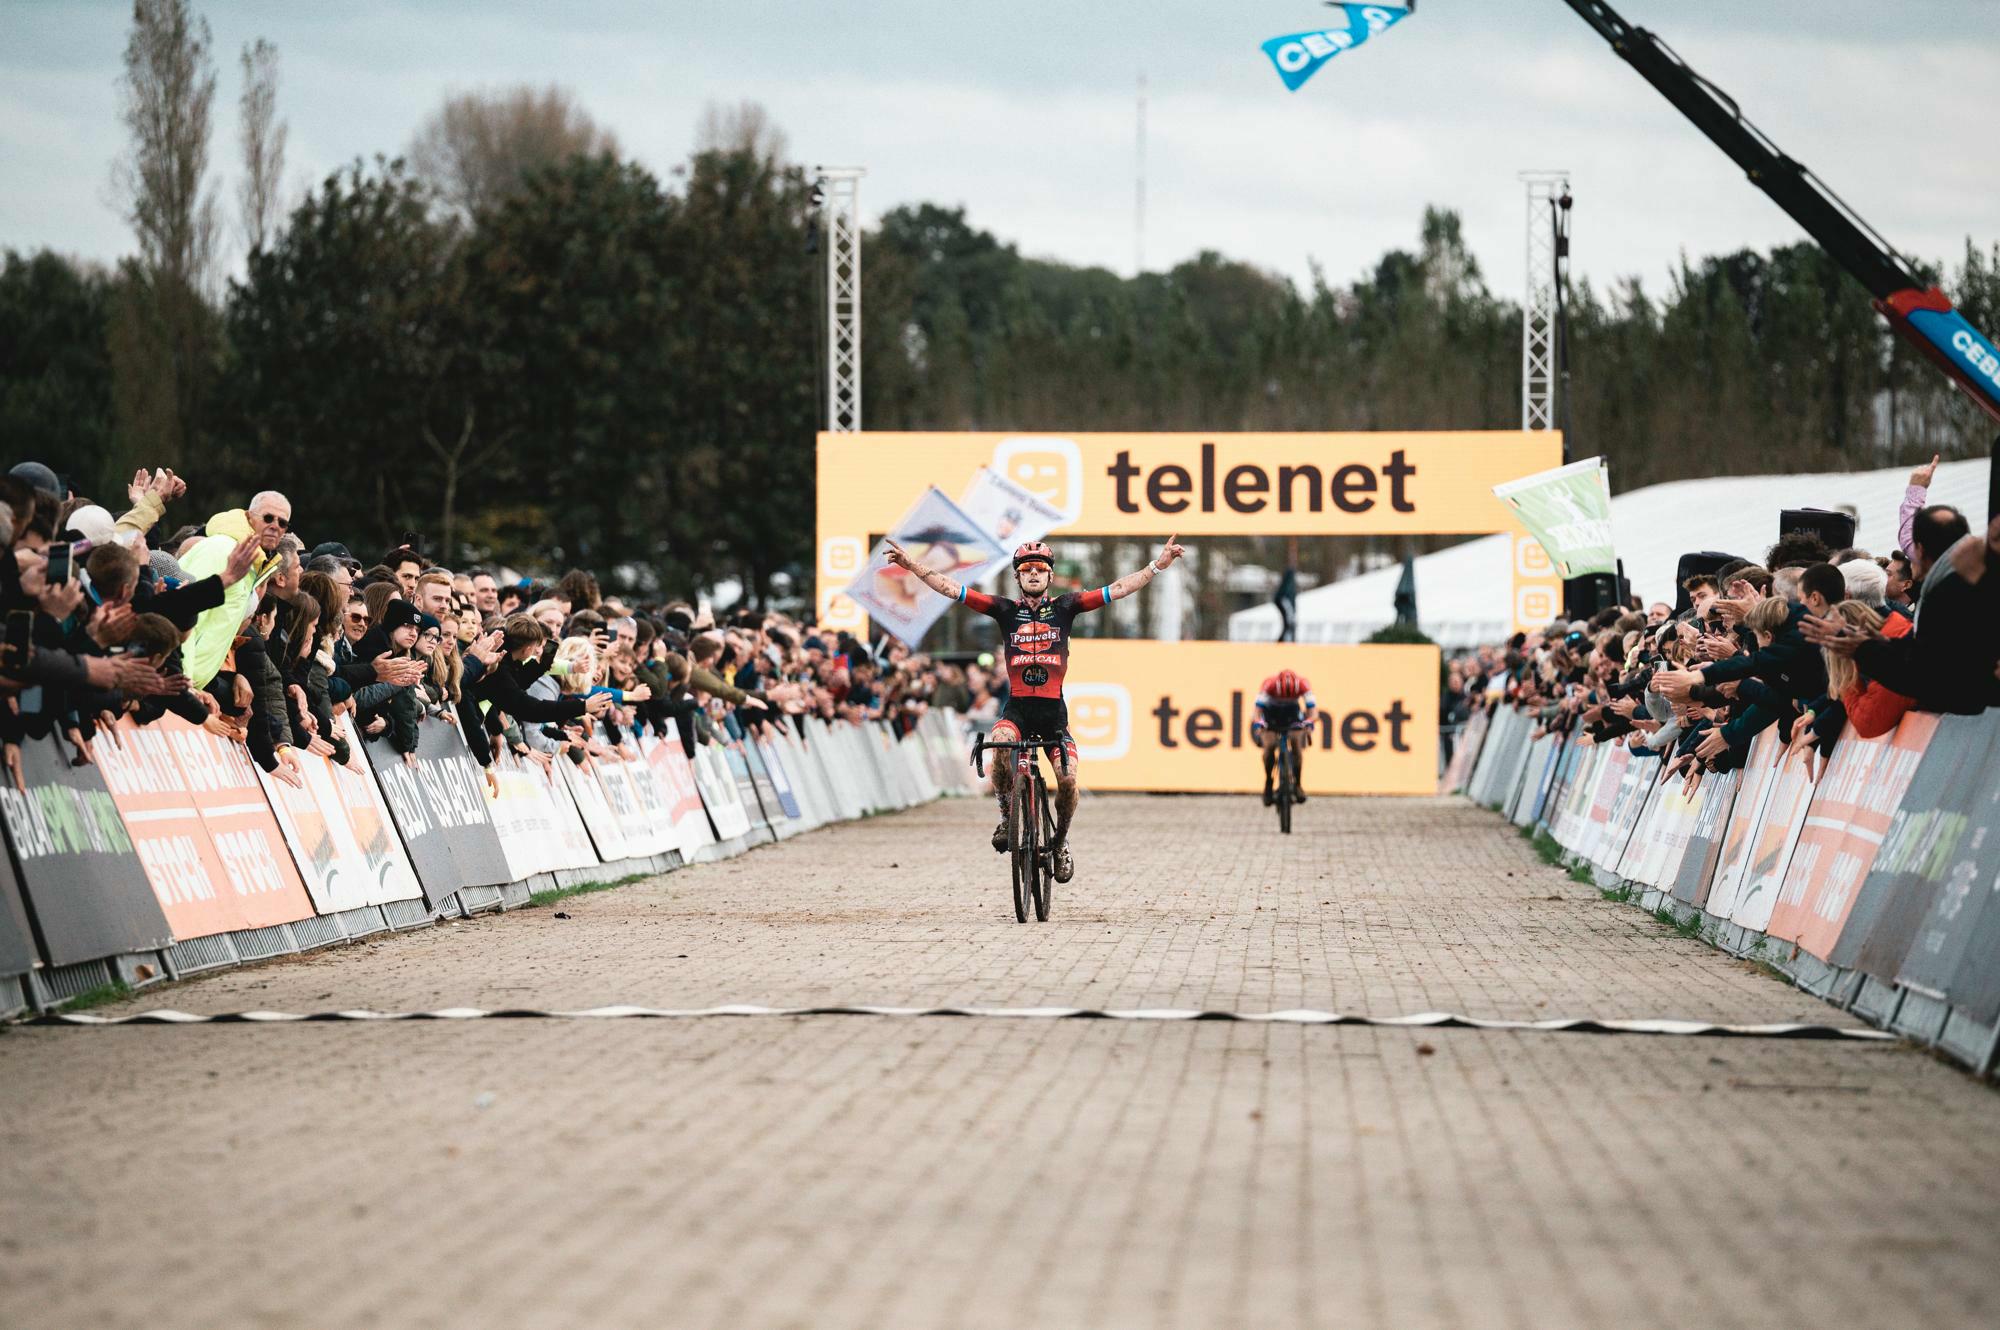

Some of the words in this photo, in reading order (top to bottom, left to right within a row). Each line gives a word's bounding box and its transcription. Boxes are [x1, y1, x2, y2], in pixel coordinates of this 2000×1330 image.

[1107, 443, 1417, 513] telenet
[1013, 630, 1058, 644] Pauwels
[1153, 691, 1411, 752] telnet
[138, 835, 216, 906] STOCK
[215, 829, 286, 897] STOCK
